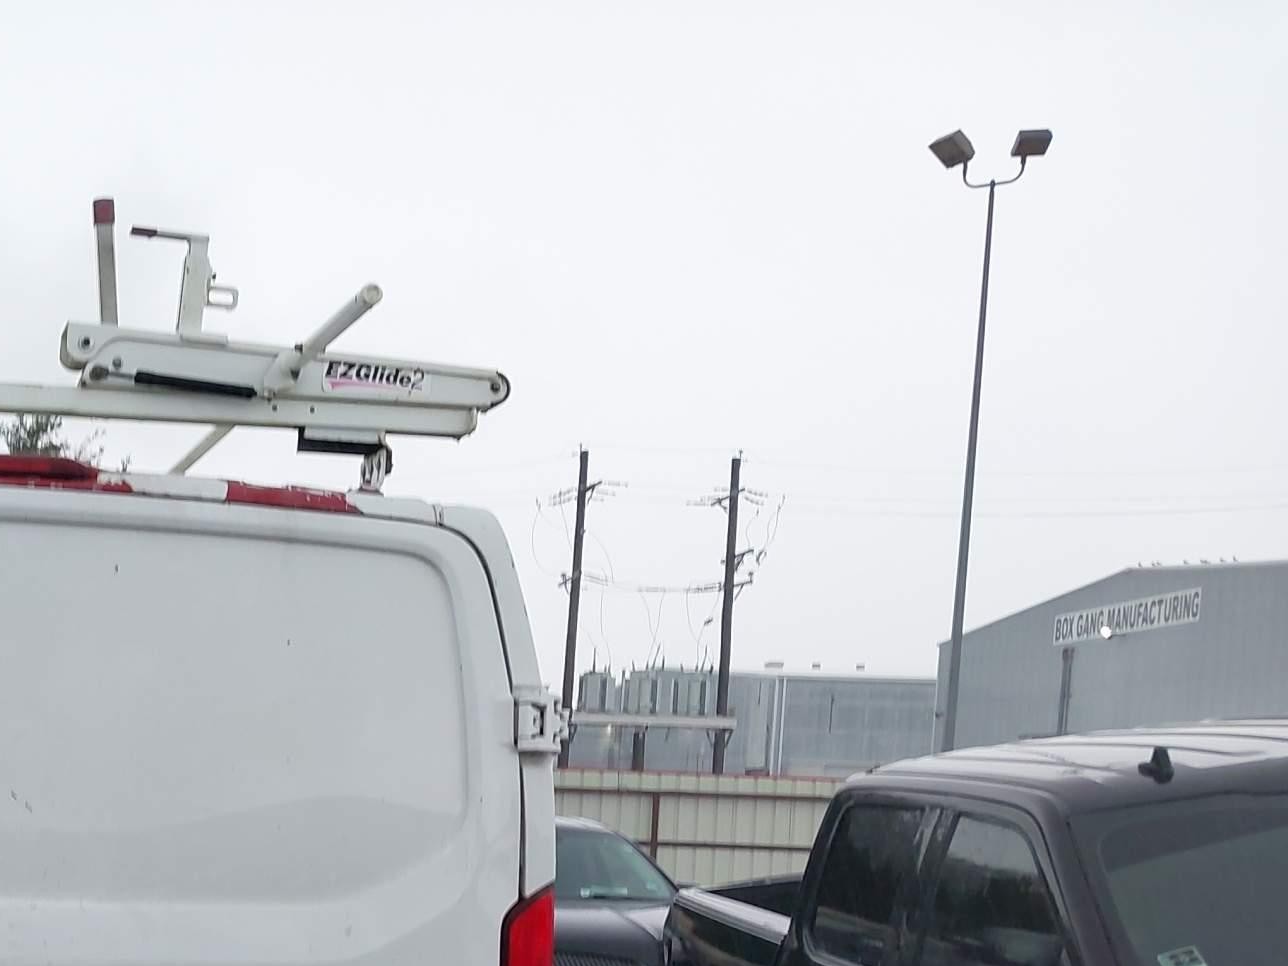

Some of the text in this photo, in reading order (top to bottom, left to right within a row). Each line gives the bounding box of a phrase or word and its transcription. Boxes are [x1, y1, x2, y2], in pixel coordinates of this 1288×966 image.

[1054, 592, 1200, 641] BOX GANG MANUFACTURING
